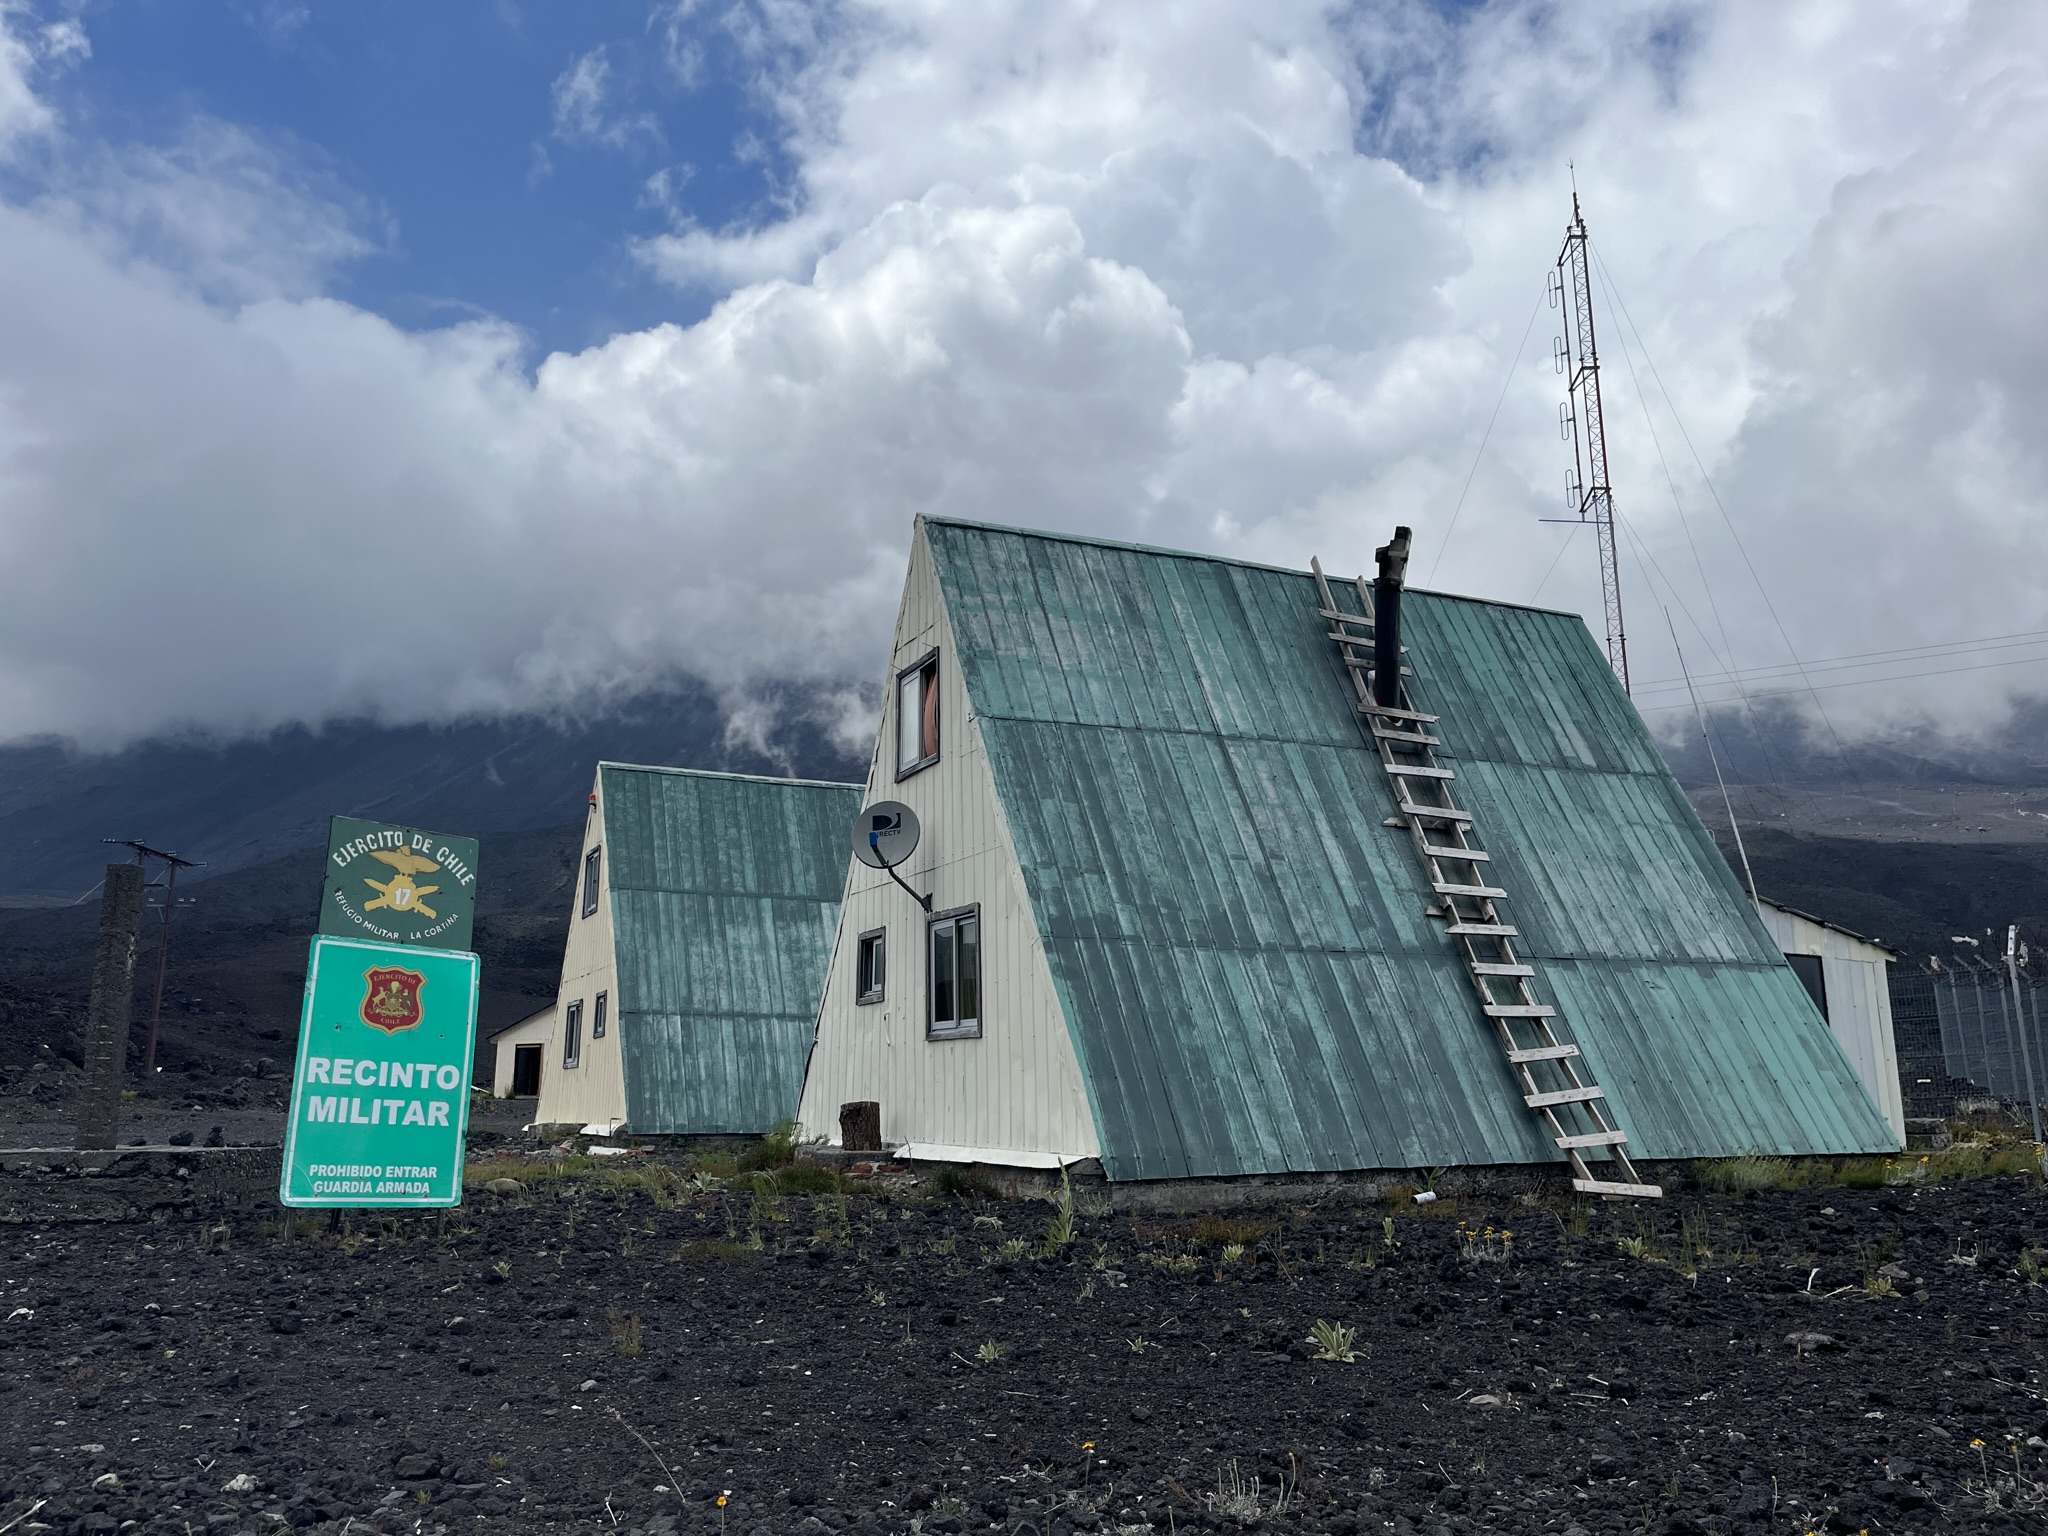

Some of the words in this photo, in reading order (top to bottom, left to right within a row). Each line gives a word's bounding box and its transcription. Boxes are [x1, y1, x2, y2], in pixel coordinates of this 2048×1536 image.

[876, 829, 901, 837] RECTV
[332, 831, 403, 867] EJERCITO
[412, 833, 433, 853] DE
[436, 846, 475, 886] CHILE
[395, 888, 411, 906] 17
[334, 890, 363, 924] REFUGIO
[362, 920, 399, 939] MILITAR
[410, 931, 421, 940] LA
[424, 913, 459, 937] CORTINA
[373, 973, 408, 982] EJERCITO
[380, 1017, 401, 1025] CHILE
[307, 1057, 460, 1090] RECINTO
[307, 1095, 450, 1126] MILITAR
[309, 1164, 382, 1178] PROHIBIDO
[385, 1166, 437, 1178] ENTRAR
[313, 1181, 372, 1193] GUARDIA
[376, 1181, 430, 1194] ARMADA
